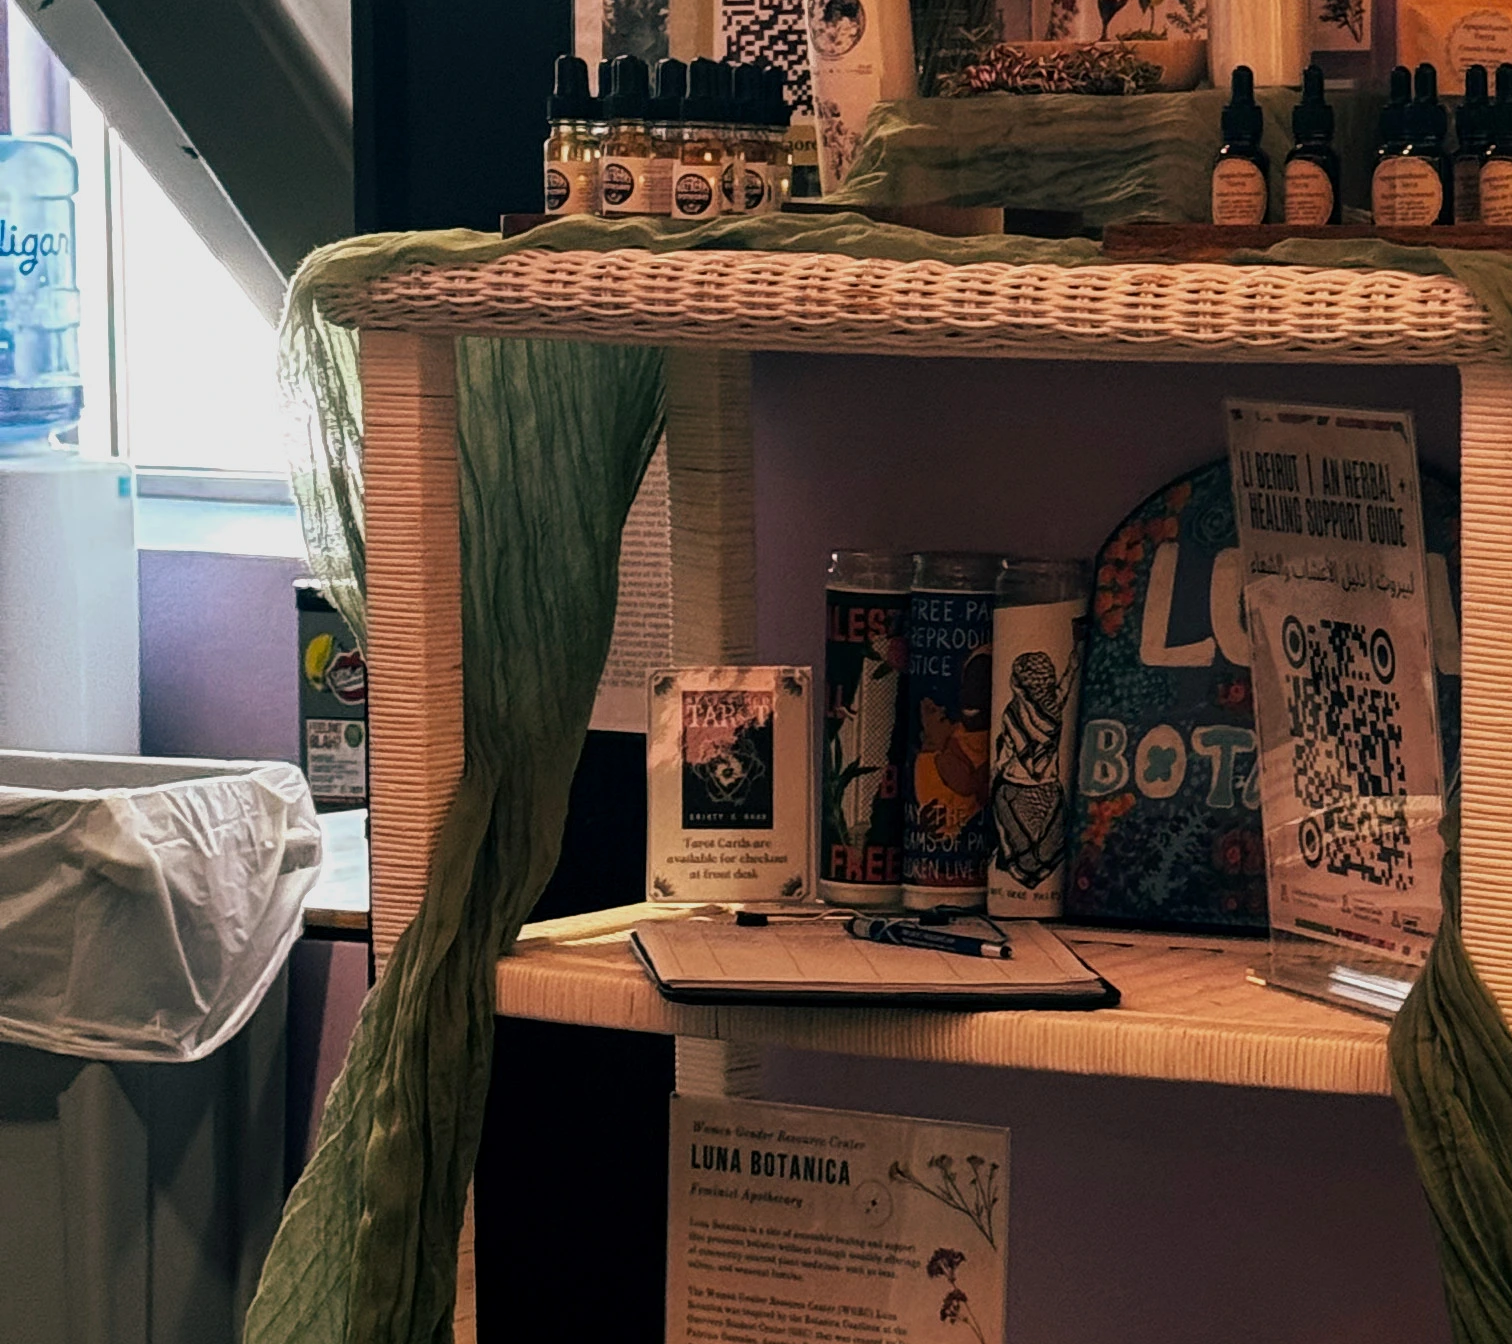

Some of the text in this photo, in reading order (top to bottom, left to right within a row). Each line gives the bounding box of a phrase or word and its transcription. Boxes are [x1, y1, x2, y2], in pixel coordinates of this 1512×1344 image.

[1255, 452, 1300, 493] BEIRUT
[1322, 457, 1340, 497] AN
[1342, 459, 1395, 503] HERBAL
[1249, 492, 1407, 548] HEALING SUPPORT GUIDE
[691, 1144, 849, 1185] LUNA BOTANICA
